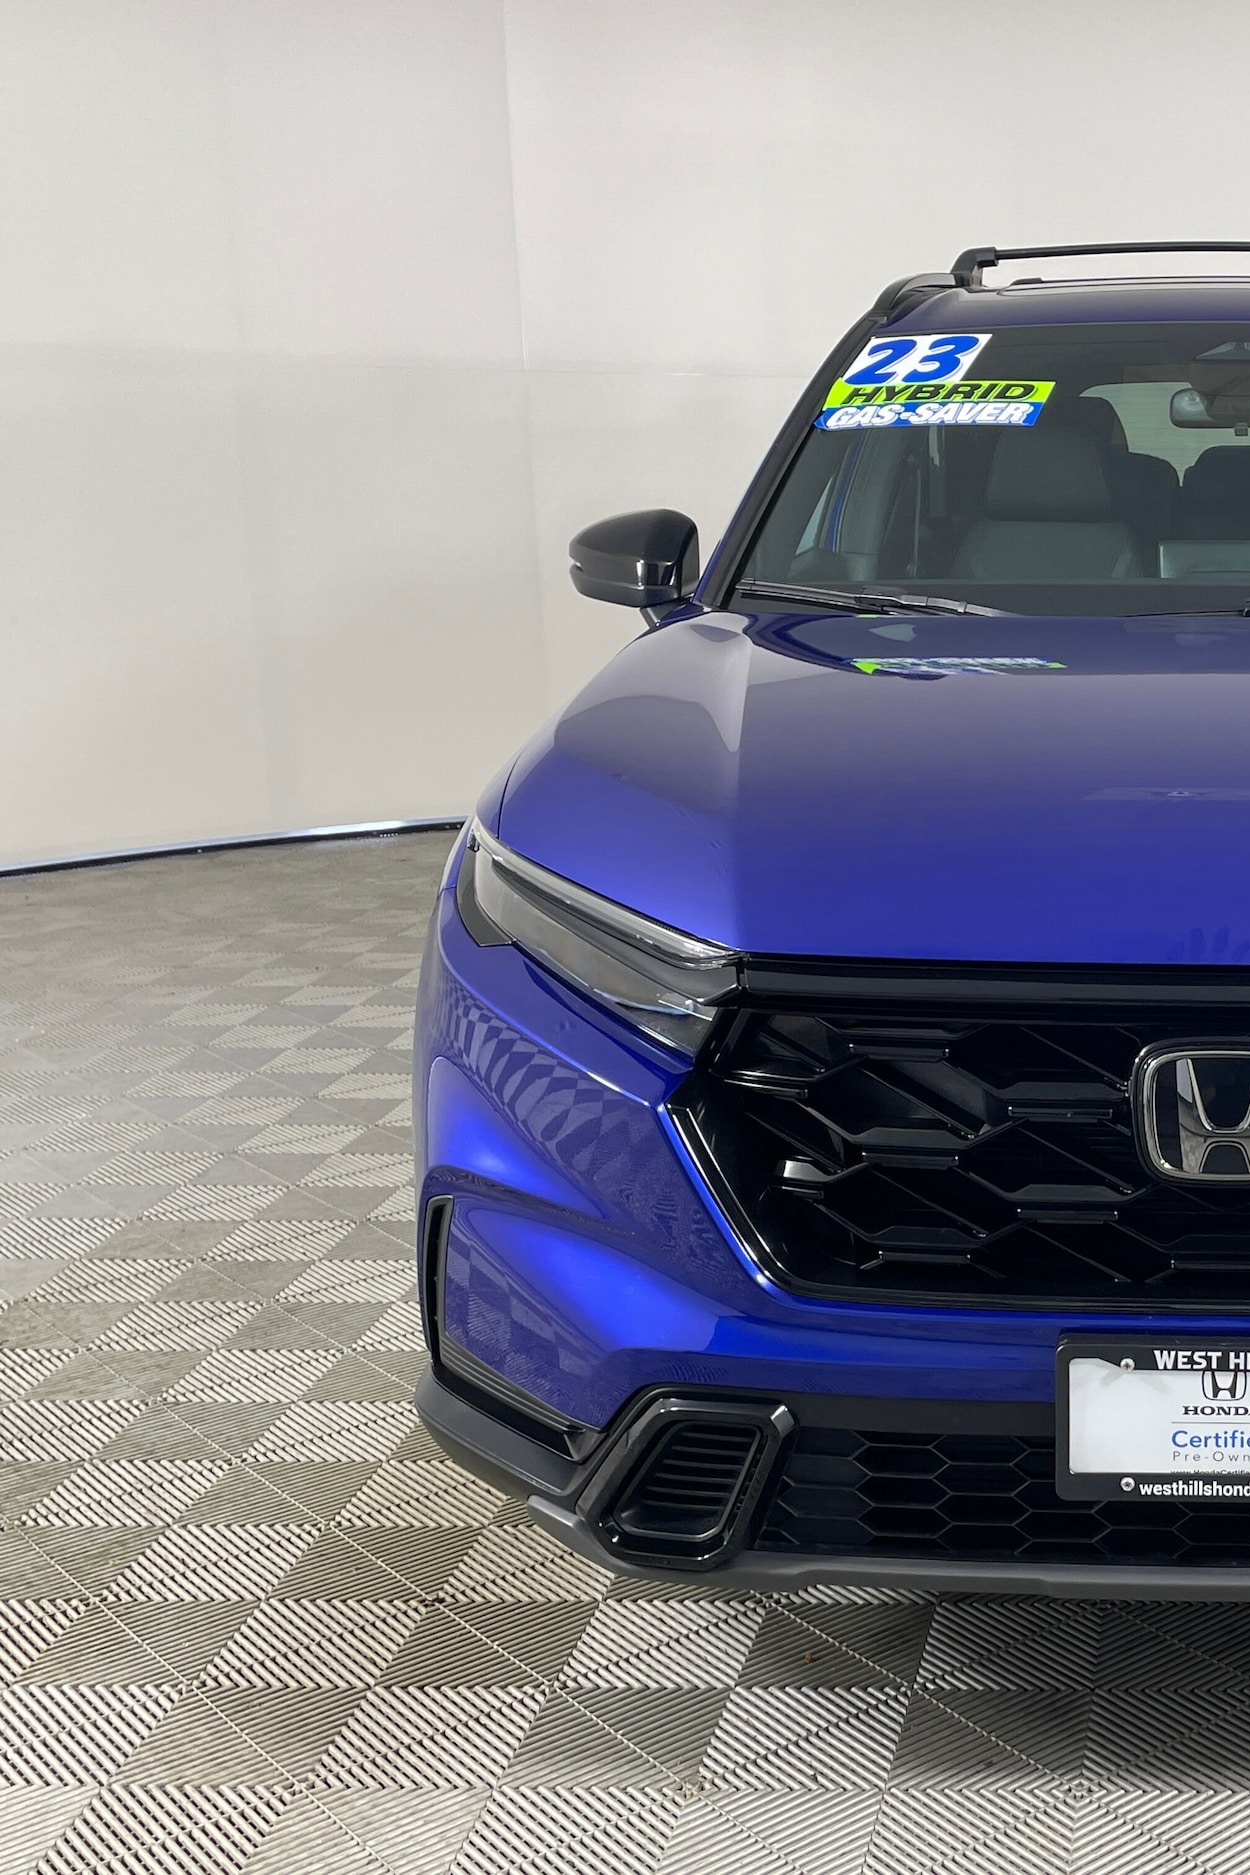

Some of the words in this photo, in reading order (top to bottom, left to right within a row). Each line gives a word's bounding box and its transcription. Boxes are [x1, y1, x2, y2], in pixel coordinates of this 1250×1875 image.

[844, 335, 983, 385] 23
[840, 382, 1039, 405] HYBRID
[826, 401, 1034, 429] GAS-SAVER
[1153, 1350, 1222, 1370] WEST
